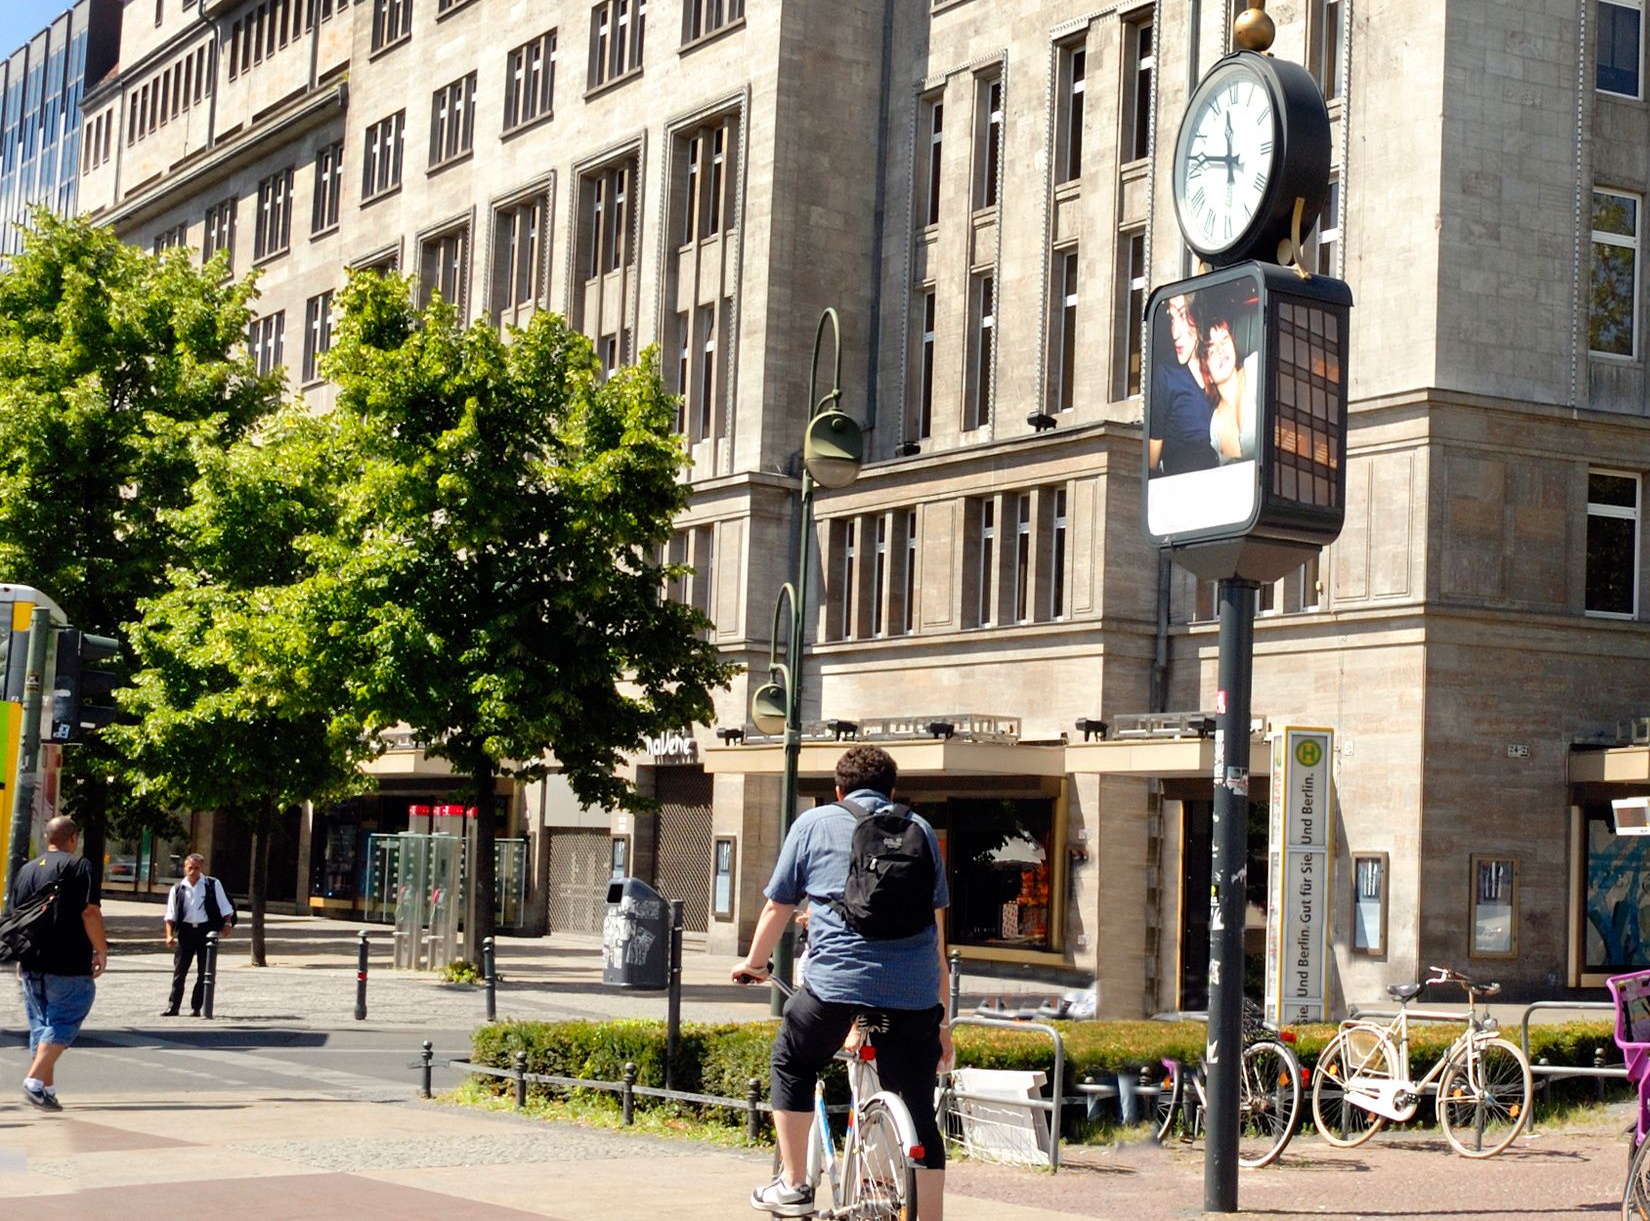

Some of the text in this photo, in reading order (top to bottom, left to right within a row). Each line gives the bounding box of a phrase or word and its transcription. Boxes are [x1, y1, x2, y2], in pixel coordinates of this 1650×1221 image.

[1301, 773, 1314, 814] Berlin.
[1300, 819, 1313, 845] Und
[1299, 878, 1312, 898] für
[1299, 900, 1312, 923] Gut
[1297, 926, 1311, 967] Berlin.
[1296, 969, 1309, 998] Und
